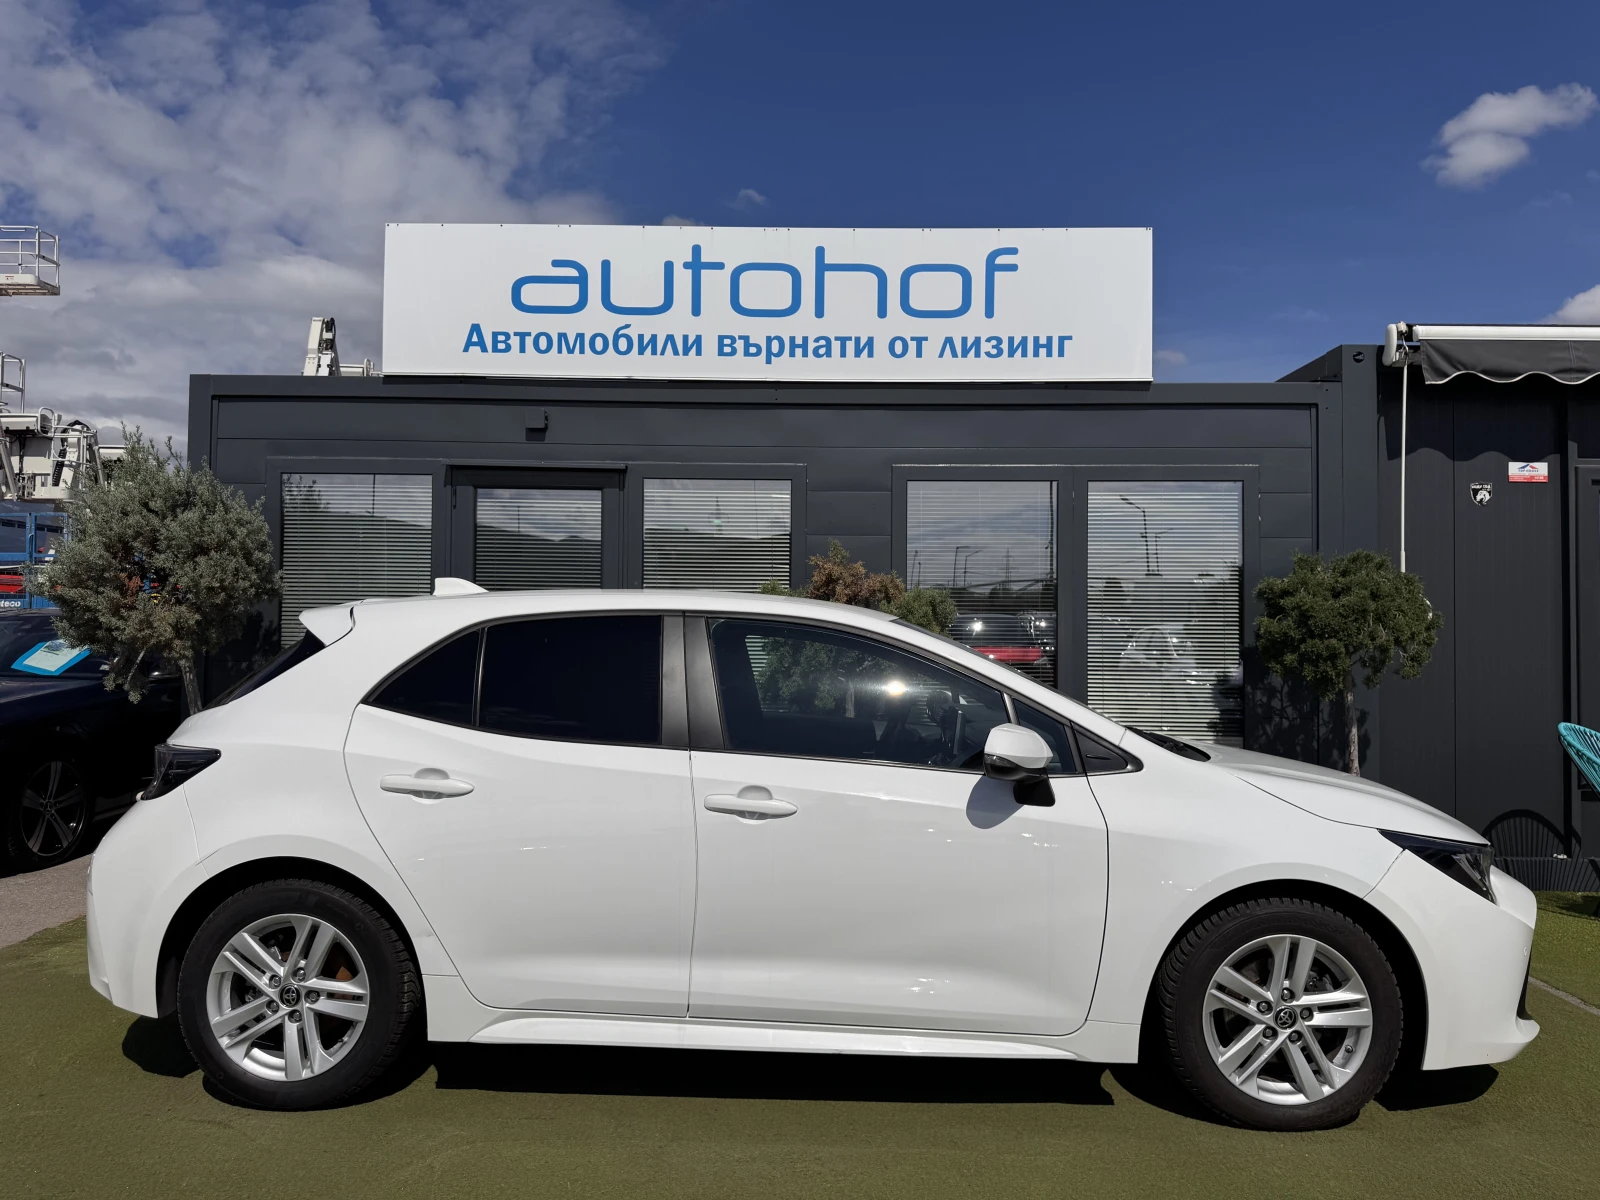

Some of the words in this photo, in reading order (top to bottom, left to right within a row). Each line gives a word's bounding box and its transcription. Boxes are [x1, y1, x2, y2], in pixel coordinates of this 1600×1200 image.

[511, 244, 1019, 319] autohof
[463, 323, 703, 357] Автомобили
[717, 334, 875, 364] върнати
[887, 335, 929, 359] от
[938, 335, 1074, 359] лизинг
